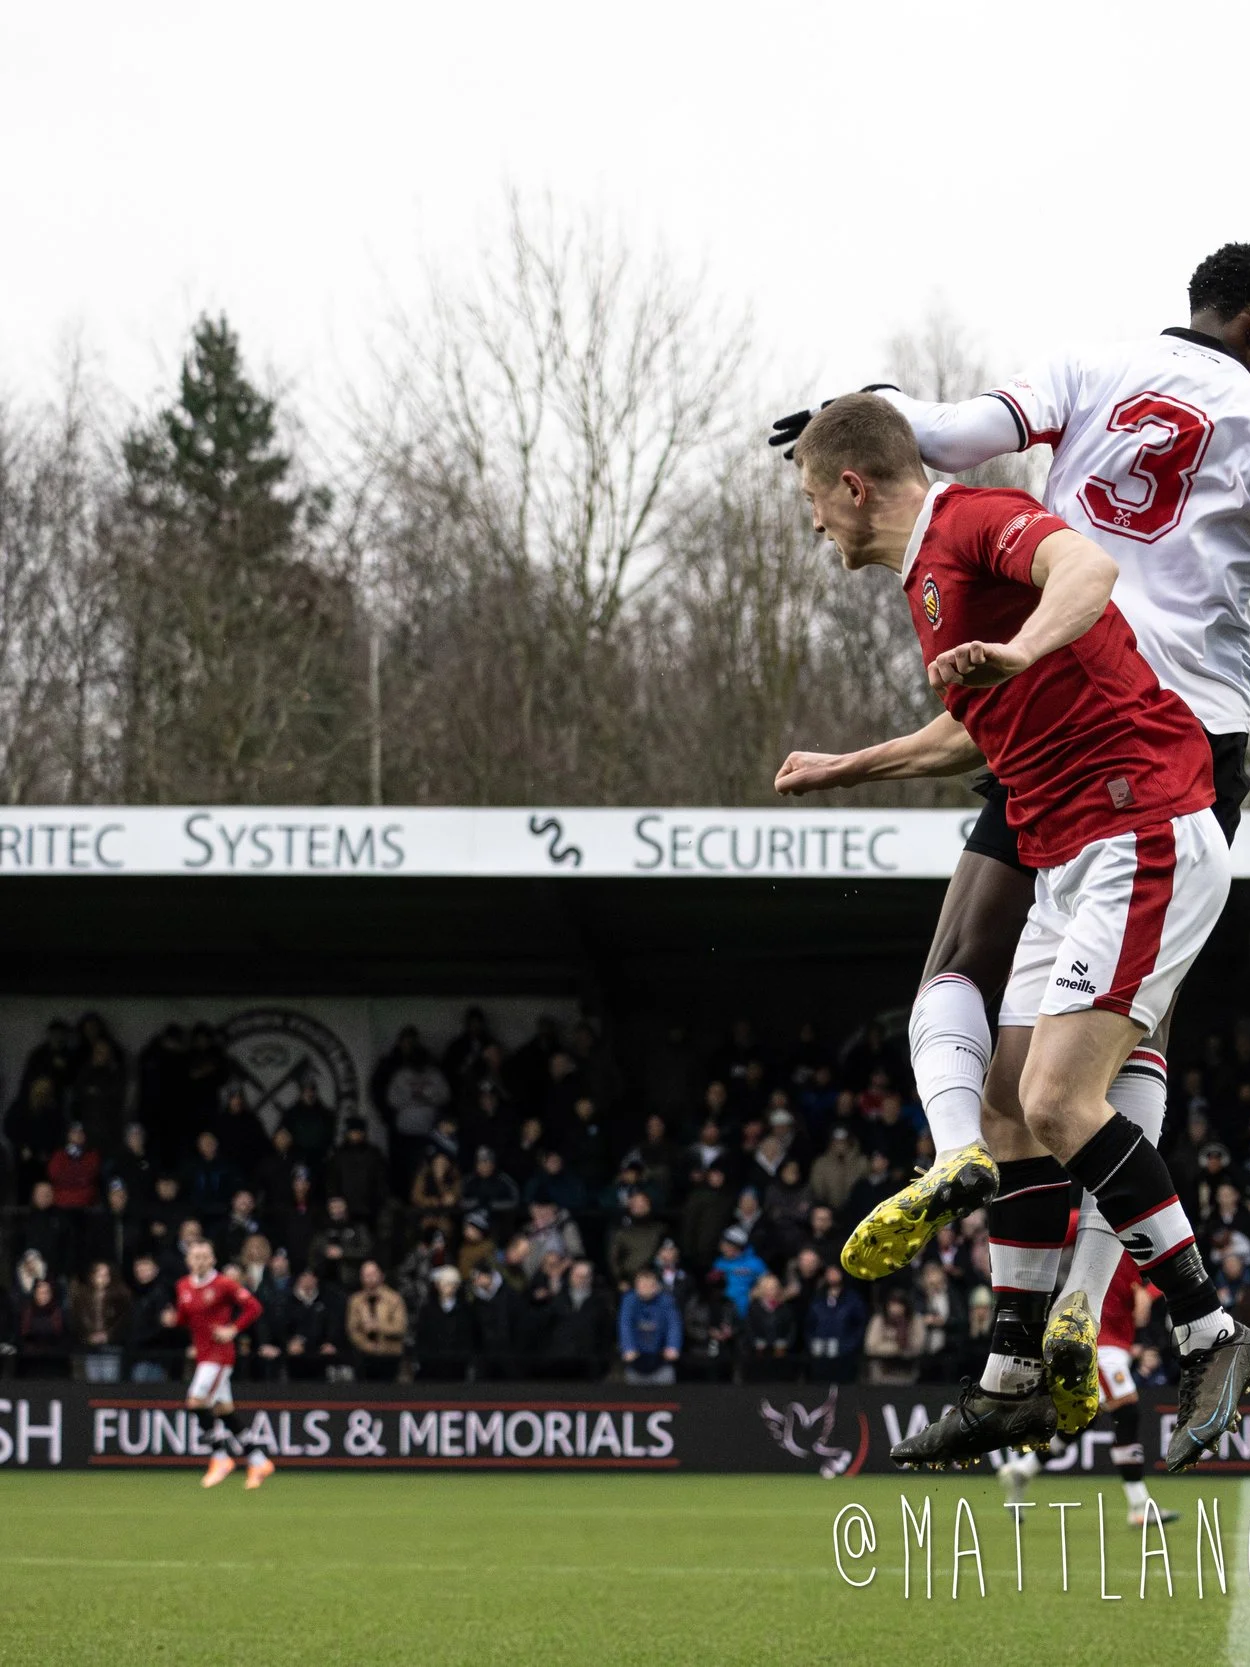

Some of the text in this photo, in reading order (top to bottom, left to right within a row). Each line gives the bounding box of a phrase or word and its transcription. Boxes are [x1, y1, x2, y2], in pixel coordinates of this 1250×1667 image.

[1076, 391, 1215, 544] 3
[183, 813, 406, 869] SYSTEMS
[634, 814, 899, 871] SECURITEC
[343, 1408, 387, 1457] &
[400, 1410, 675, 1458] MEMORIALS
